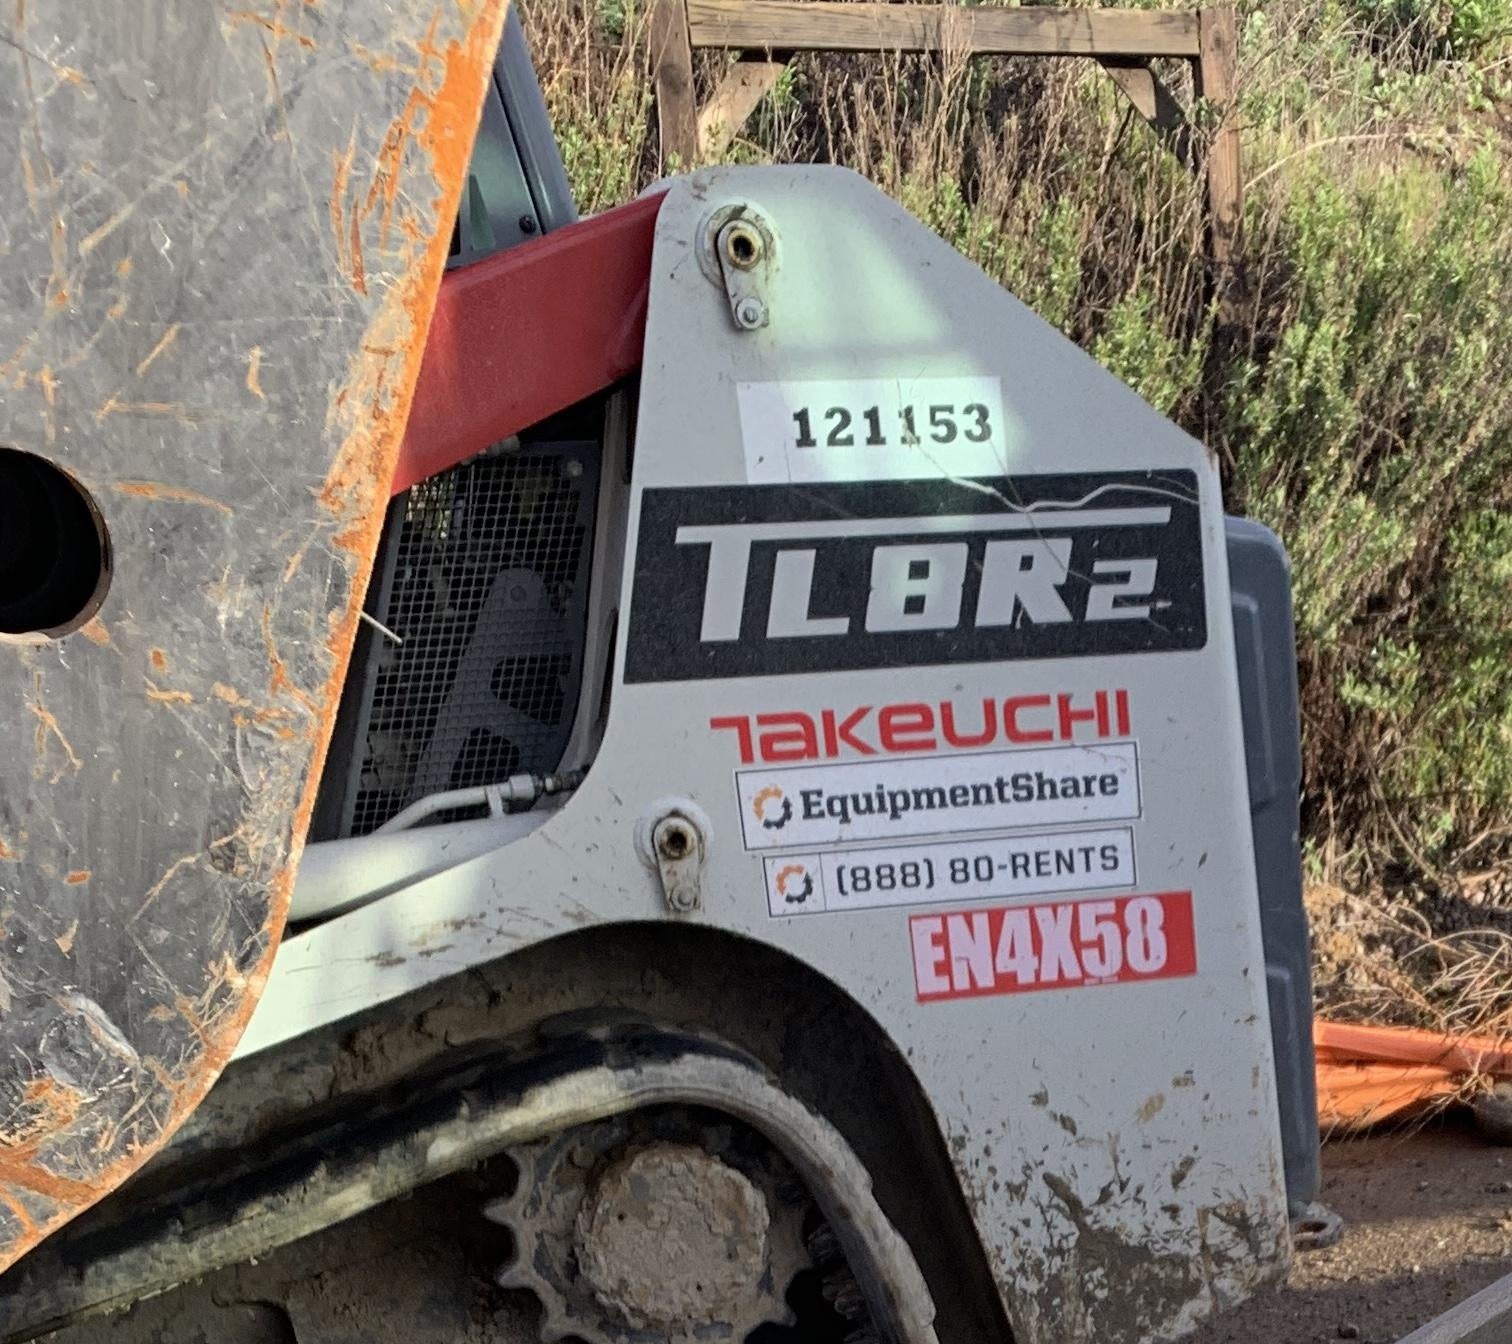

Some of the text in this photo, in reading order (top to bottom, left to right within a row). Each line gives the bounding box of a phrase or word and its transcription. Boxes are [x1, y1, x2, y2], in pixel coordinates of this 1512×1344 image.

[793, 403, 992, 448] 121153
[800, 771, 1120, 822] EquipmentShare
[836, 844, 1120, 896] (888) 80-RENTS
[911, 896, 1168, 996] EN4X58
